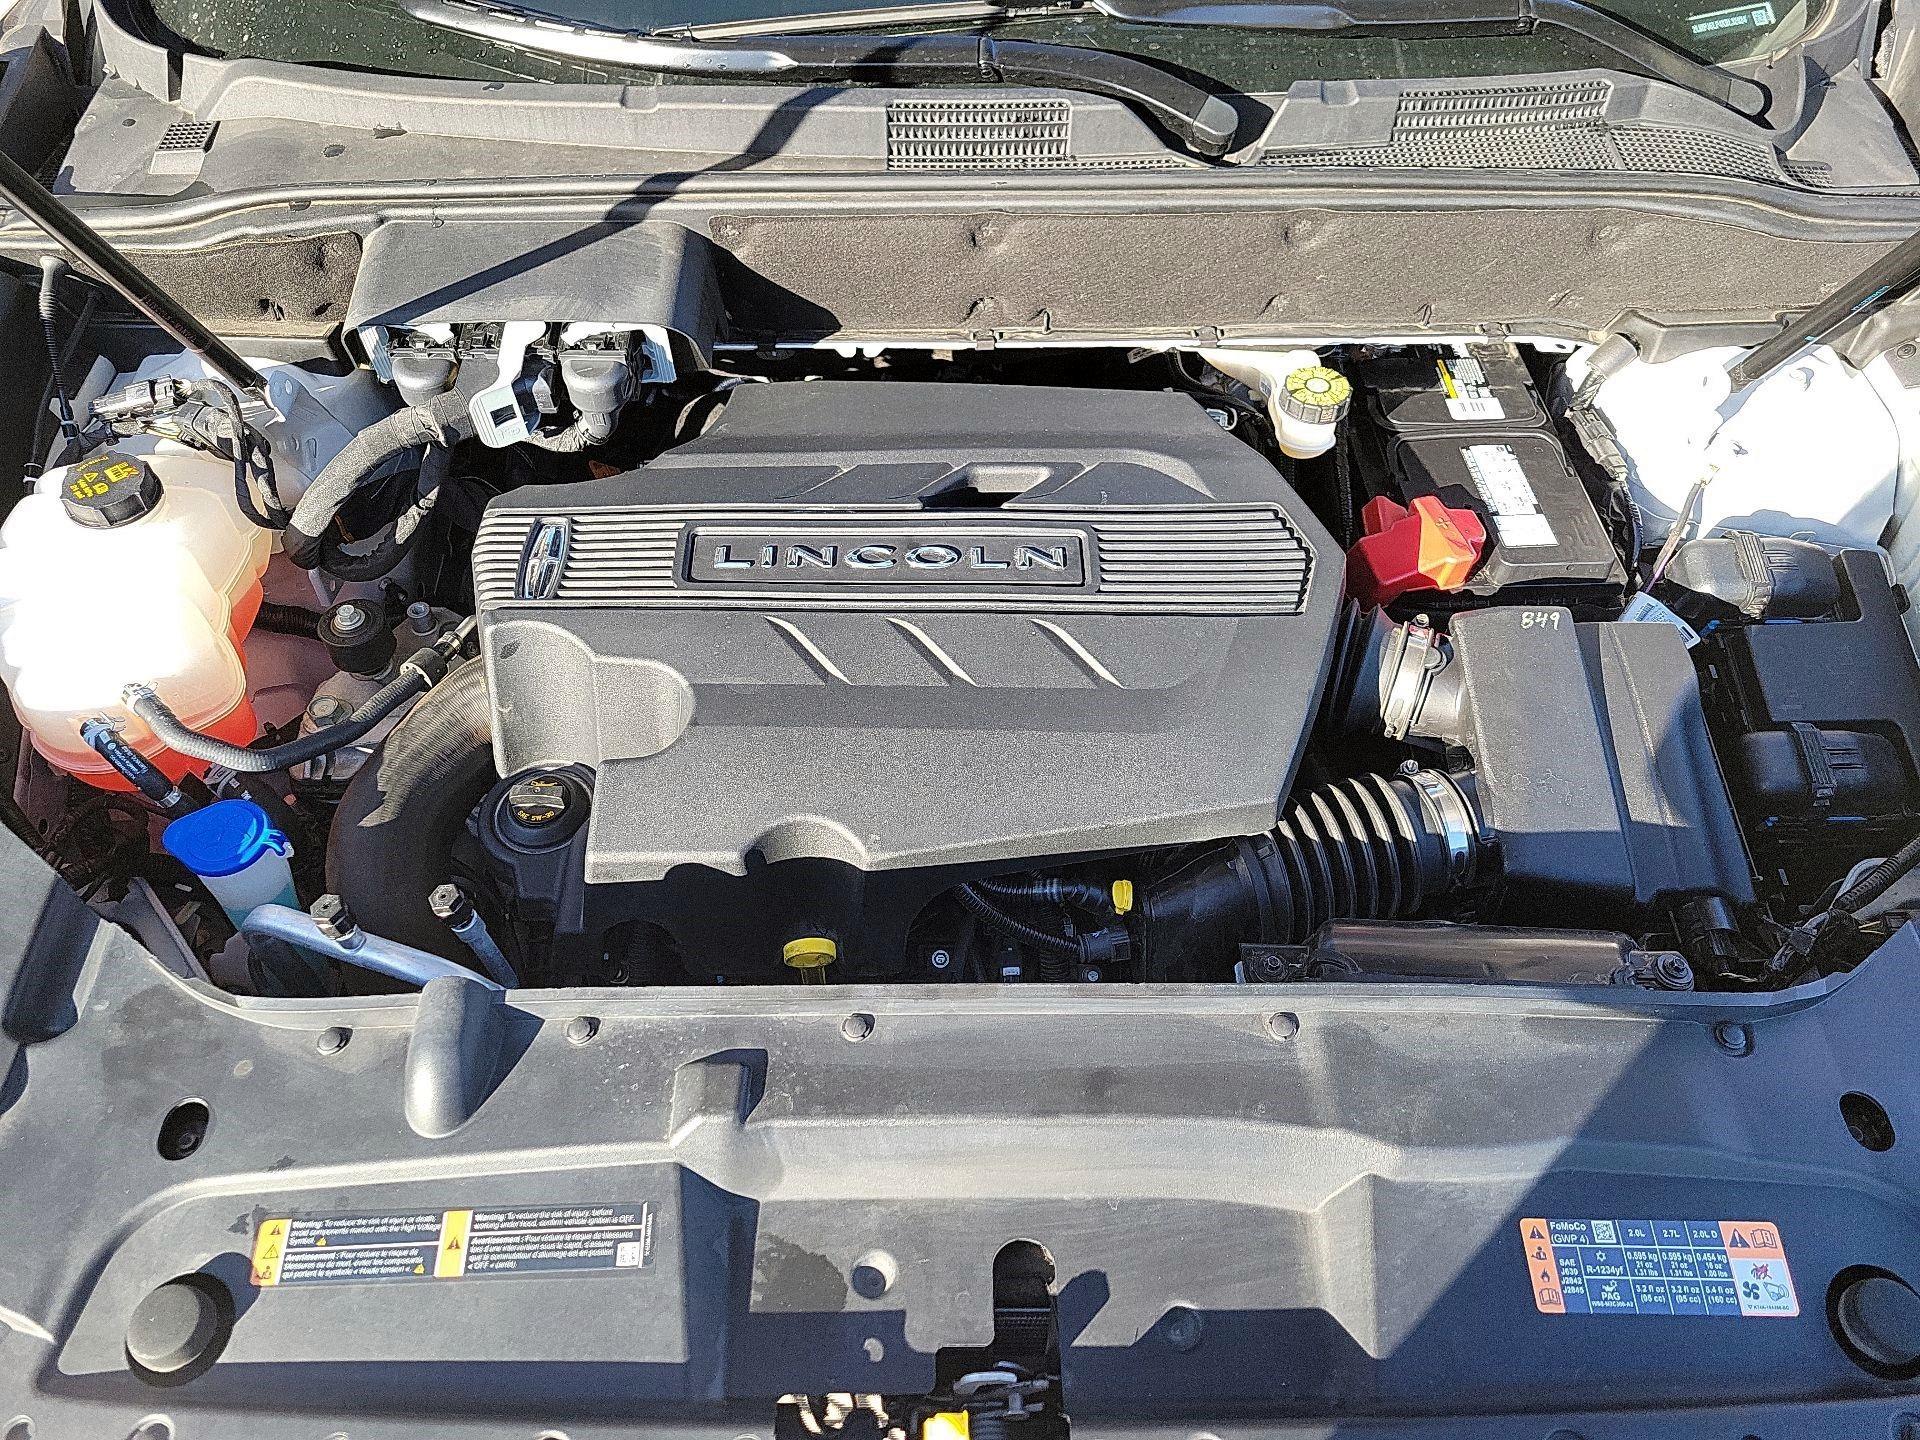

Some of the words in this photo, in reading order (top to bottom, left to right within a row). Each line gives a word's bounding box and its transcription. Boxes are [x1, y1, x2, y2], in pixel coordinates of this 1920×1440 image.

[713, 545, 1068, 570] LINCOLN
[518, 809, 530, 820] SAE
[531, 810, 555, 821] 5W-30
[475, 1212, 506, 1222] Warning:
[507, 1211, 515, 1219] To
[516, 1211, 538, 1219] reduce
[539, 1210, 550, 1218] the
[564, 1209, 571, 1217] of
[592, 1208, 613, 1216] before
[292, 1220, 324, 1229] Warning:
[325, 1219, 333, 1227] To
[334, 1219, 357, 1227] reduce
[368, 1217, 380, 1225] risk
[381, 1216, 389, 1224] of
[474, 1222, 500, 1230] working
[500, 1220, 518, 1228] under
[1550, 1221, 1586, 1230] FoMoCo
[309, 1227, 349, 1237] components
[388, 1224, 400, 1232] the
[400, 1223, 416, 1233] High
[1628, 1229, 1646, 1237] 2.0L
[1662, 1230, 1680, 1238] 2.7L
[1692, 1230, 1710, 1238] 2.0L
[1551, 1234, 1577, 1244] (GWP
[1580, 1234, 1589, 1245] 4)
[340, 1251, 356, 1259] Pour
[1647, 1252, 1658, 1262] kg
[1682, 1252, 1693, 1262] kg
[1696, 1253, 1716, 1261] 0.454
[1717, 1253, 1727, 1263] kg
[474, 1261, 489, 1269] OFF
[1587, 1265, 1623, 1276] R-1234yf
[1671, 1285, 1682, 1293] 3.2
[1601, 1292, 1620, 1300] PAG
[1654, 1295, 1665, 1303] cc)
[1689, 1295, 1700, 1304] cc)
[1726, 1296, 1737, 1305] cc)
